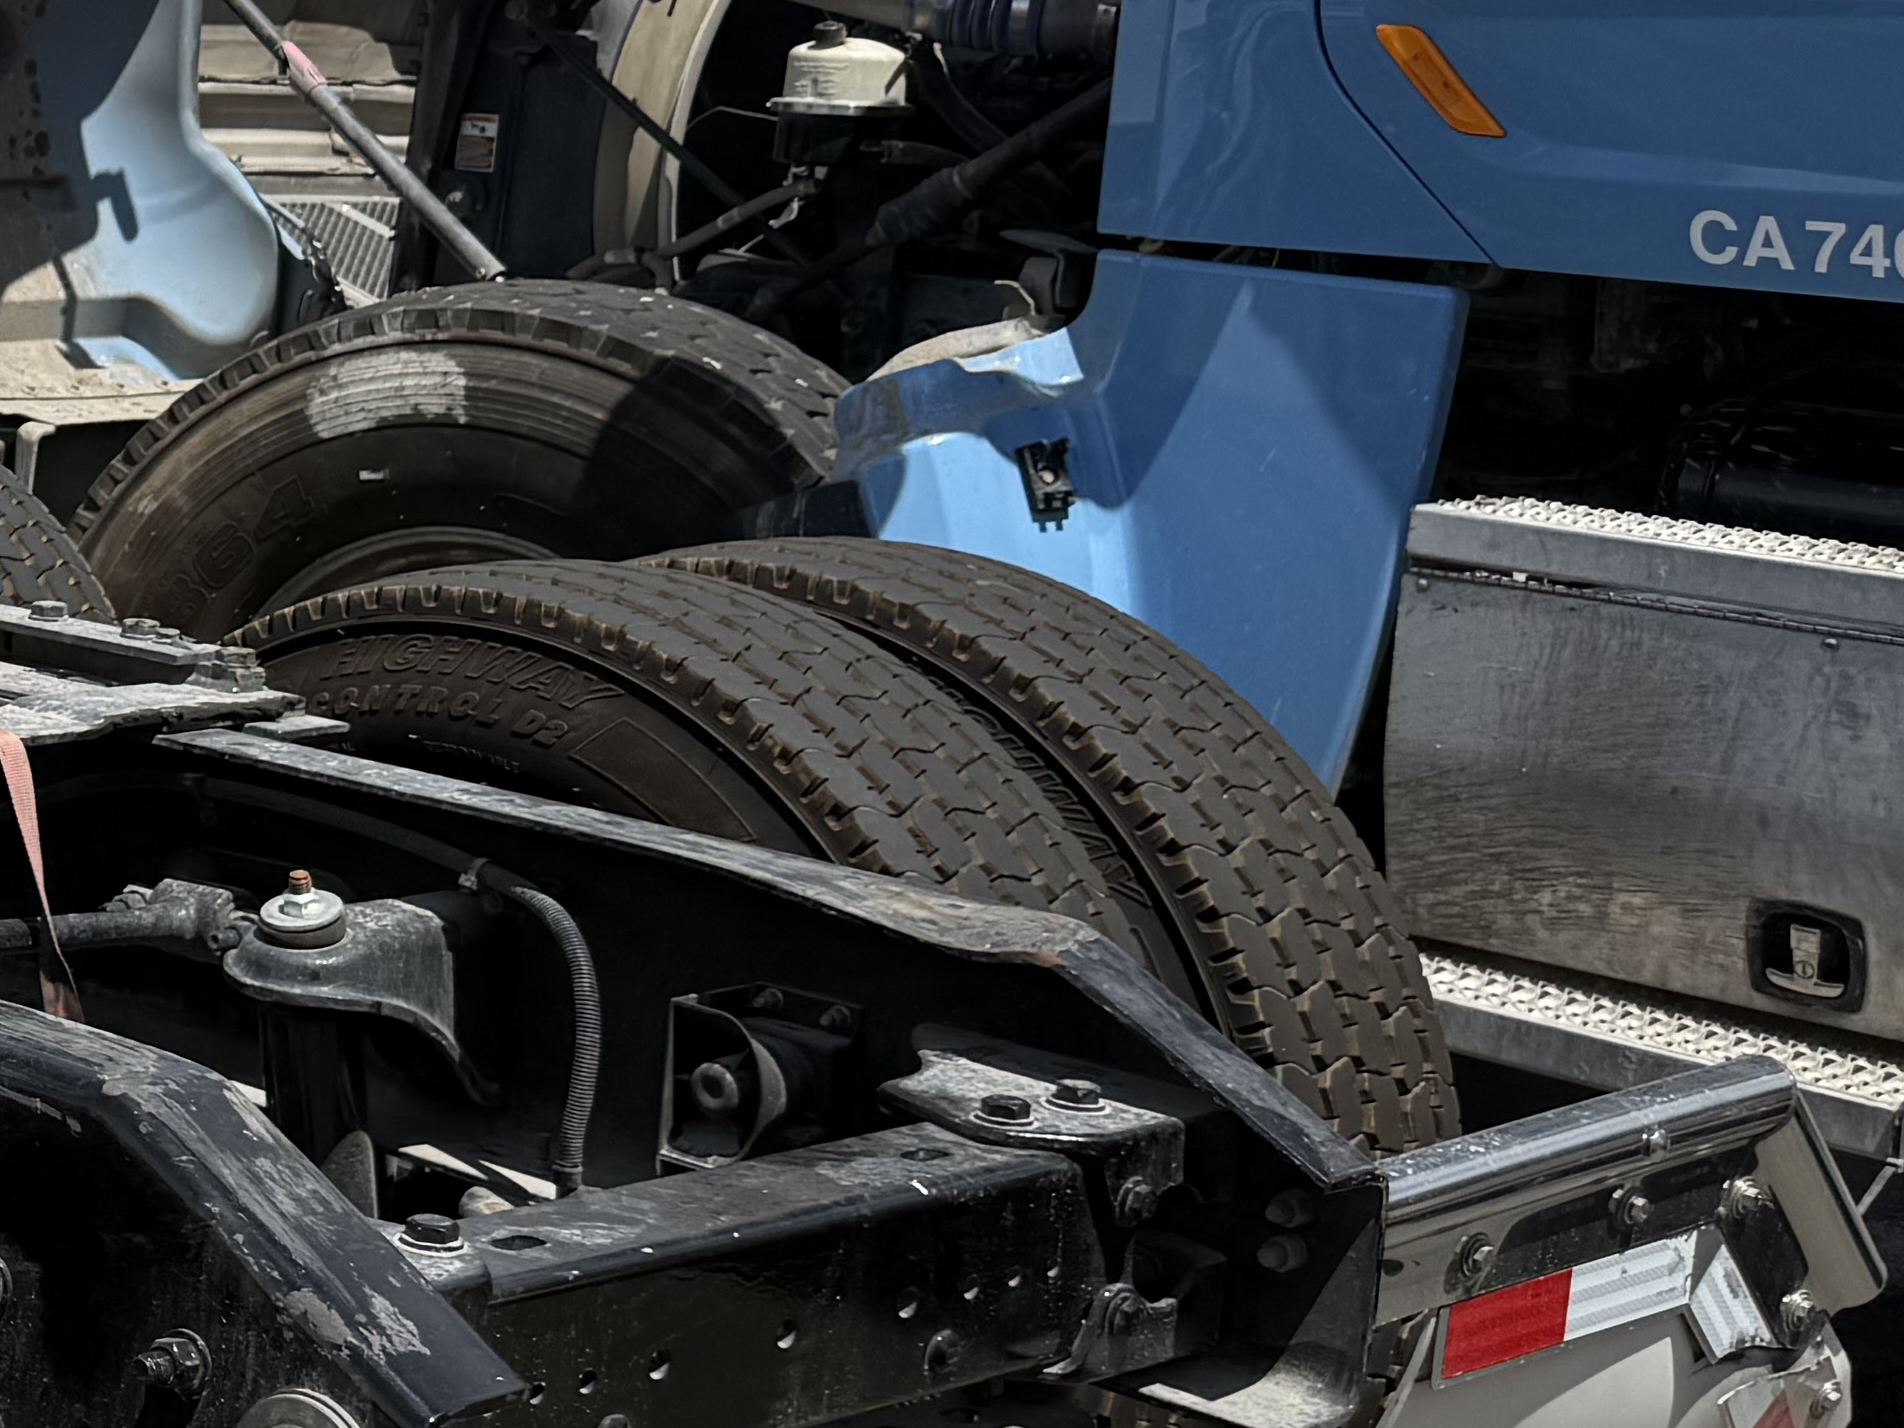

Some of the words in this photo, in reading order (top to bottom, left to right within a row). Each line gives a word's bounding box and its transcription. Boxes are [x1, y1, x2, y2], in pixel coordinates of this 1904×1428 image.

[1689, 209, 1796, 271] CA
[311, 685, 503, 727] CONTROL
[510, 709, 569, 748] D2
